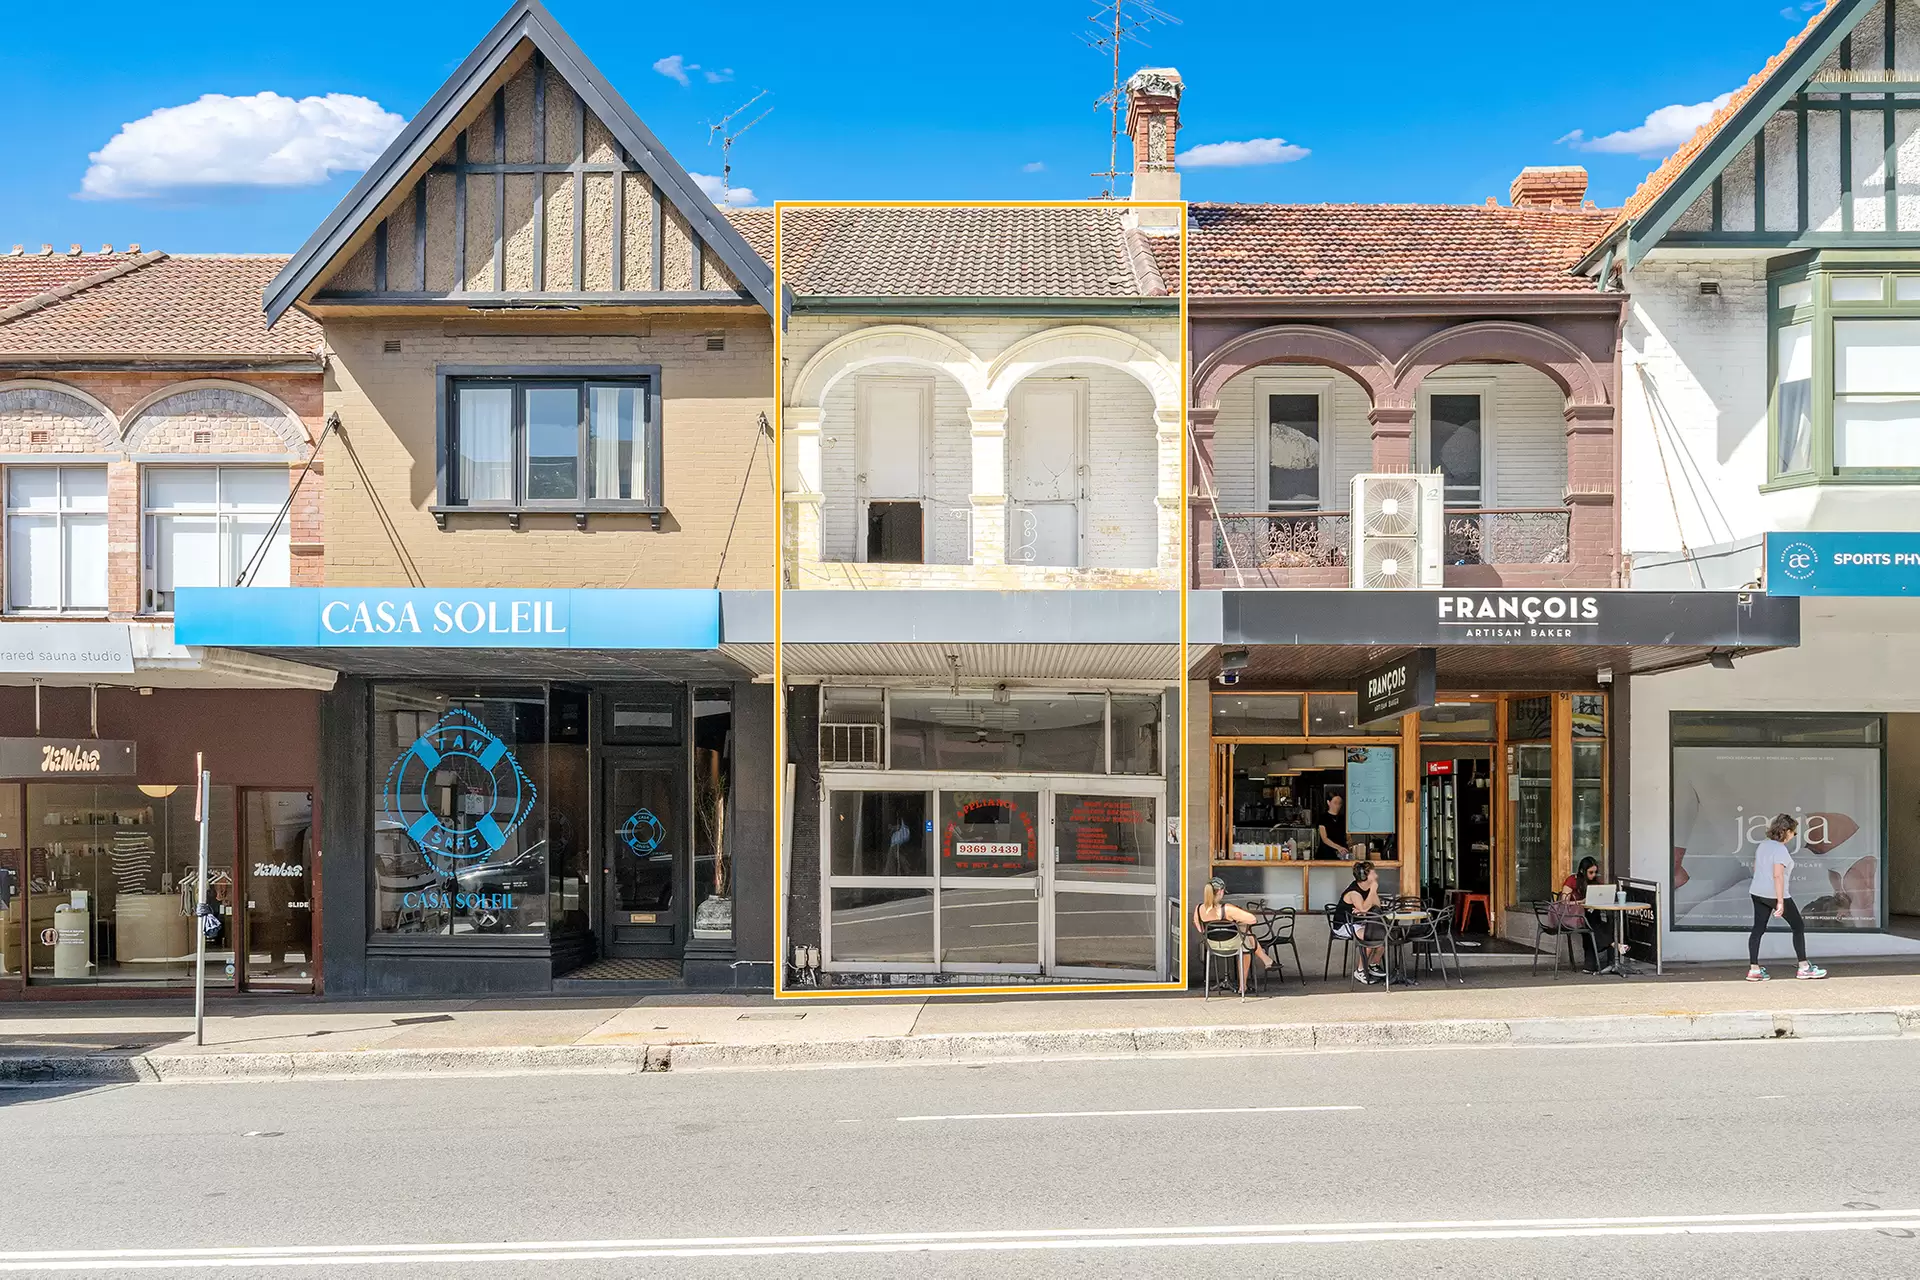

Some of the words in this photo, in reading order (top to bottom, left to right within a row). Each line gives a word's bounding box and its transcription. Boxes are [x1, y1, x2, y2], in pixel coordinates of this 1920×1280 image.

[1833, 553, 1891, 565] SPORTS
[321, 600, 422, 634] CASA
[433, 600, 567, 634] SOLEIL
[1438, 596, 1599, 625] FRANÇOIS
[1466, 629, 1521, 637] ARTISAN
[1531, 629, 1572, 637] BAKER
[39, 652, 77, 661] sauna
[81, 650, 122, 661] studio
[1368, 665, 1406, 698] FRANÇOIS
[436, 735, 483, 752] TAN
[431, 832, 479, 850] SAFE
[959, 845, 987, 853] 9369
[991, 845, 1019, 854] 3439
[403, 892, 450, 908] CASA
[455, 893, 518, 909] SOLEIL
